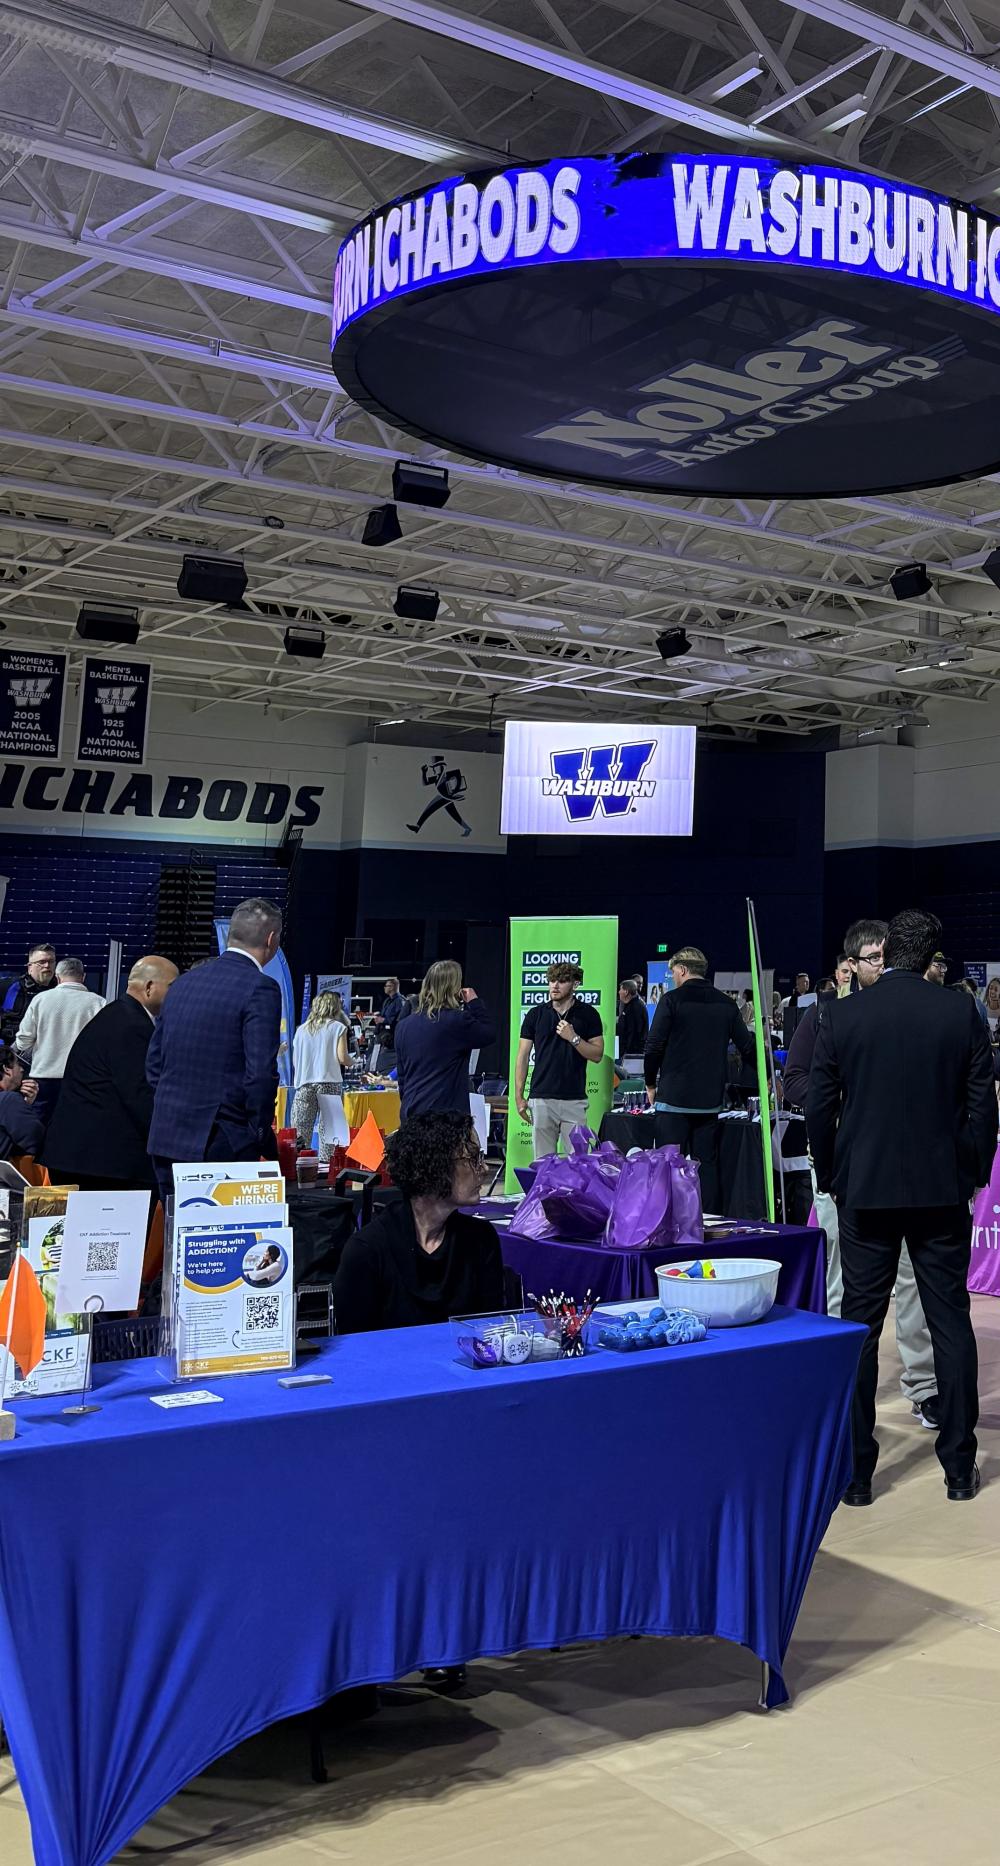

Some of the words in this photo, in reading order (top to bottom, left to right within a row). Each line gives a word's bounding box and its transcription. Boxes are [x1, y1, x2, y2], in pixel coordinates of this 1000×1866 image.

[372, 167, 582, 300] ICHABODS
[671, 163, 968, 293] WASHBURN
[532, 320, 895, 458] Noller
[656, 423, 776, 468] Auto
[759, 355, 940, 424] Group
[10, 655, 54, 666] WOMEN'S
[2, 662, 61, 675] BASKETBALL
[104, 665, 131, 674] MEN'S
[89, 671, 145, 683] BASKETBALL
[14, 711, 41, 721] 2005
[11, 721, 41, 731] NCAA
[103, 719, 124, 728] 1925
[102, 729, 124, 738] AAU
[0, 741, 56, 752] HAMPIONS
[86, 737, 137, 749] NATIONAL
[81, 747, 140, 759] CHAMPIONS
[541, 778, 657, 798] WASHBURN
[0, 763, 325, 827] ICHABODS
[525, 954, 579, 965] LOOKING
[524, 973, 548, 984] FOR
[523, 992, 551, 1004] FIGU
[575, 993, 599, 1003] OB?
[240, 1183, 279, 1195] WE'RE
[232, 1194, 279, 1206] HIRING!
[187, 1238, 228, 1249] Struggling
[188, 1246, 238, 1256] ADDICTION?
[195, 1268, 212, 1276] help
[211, 1267, 227, 1275] you!
[42, 1346, 74, 1362] CKF
